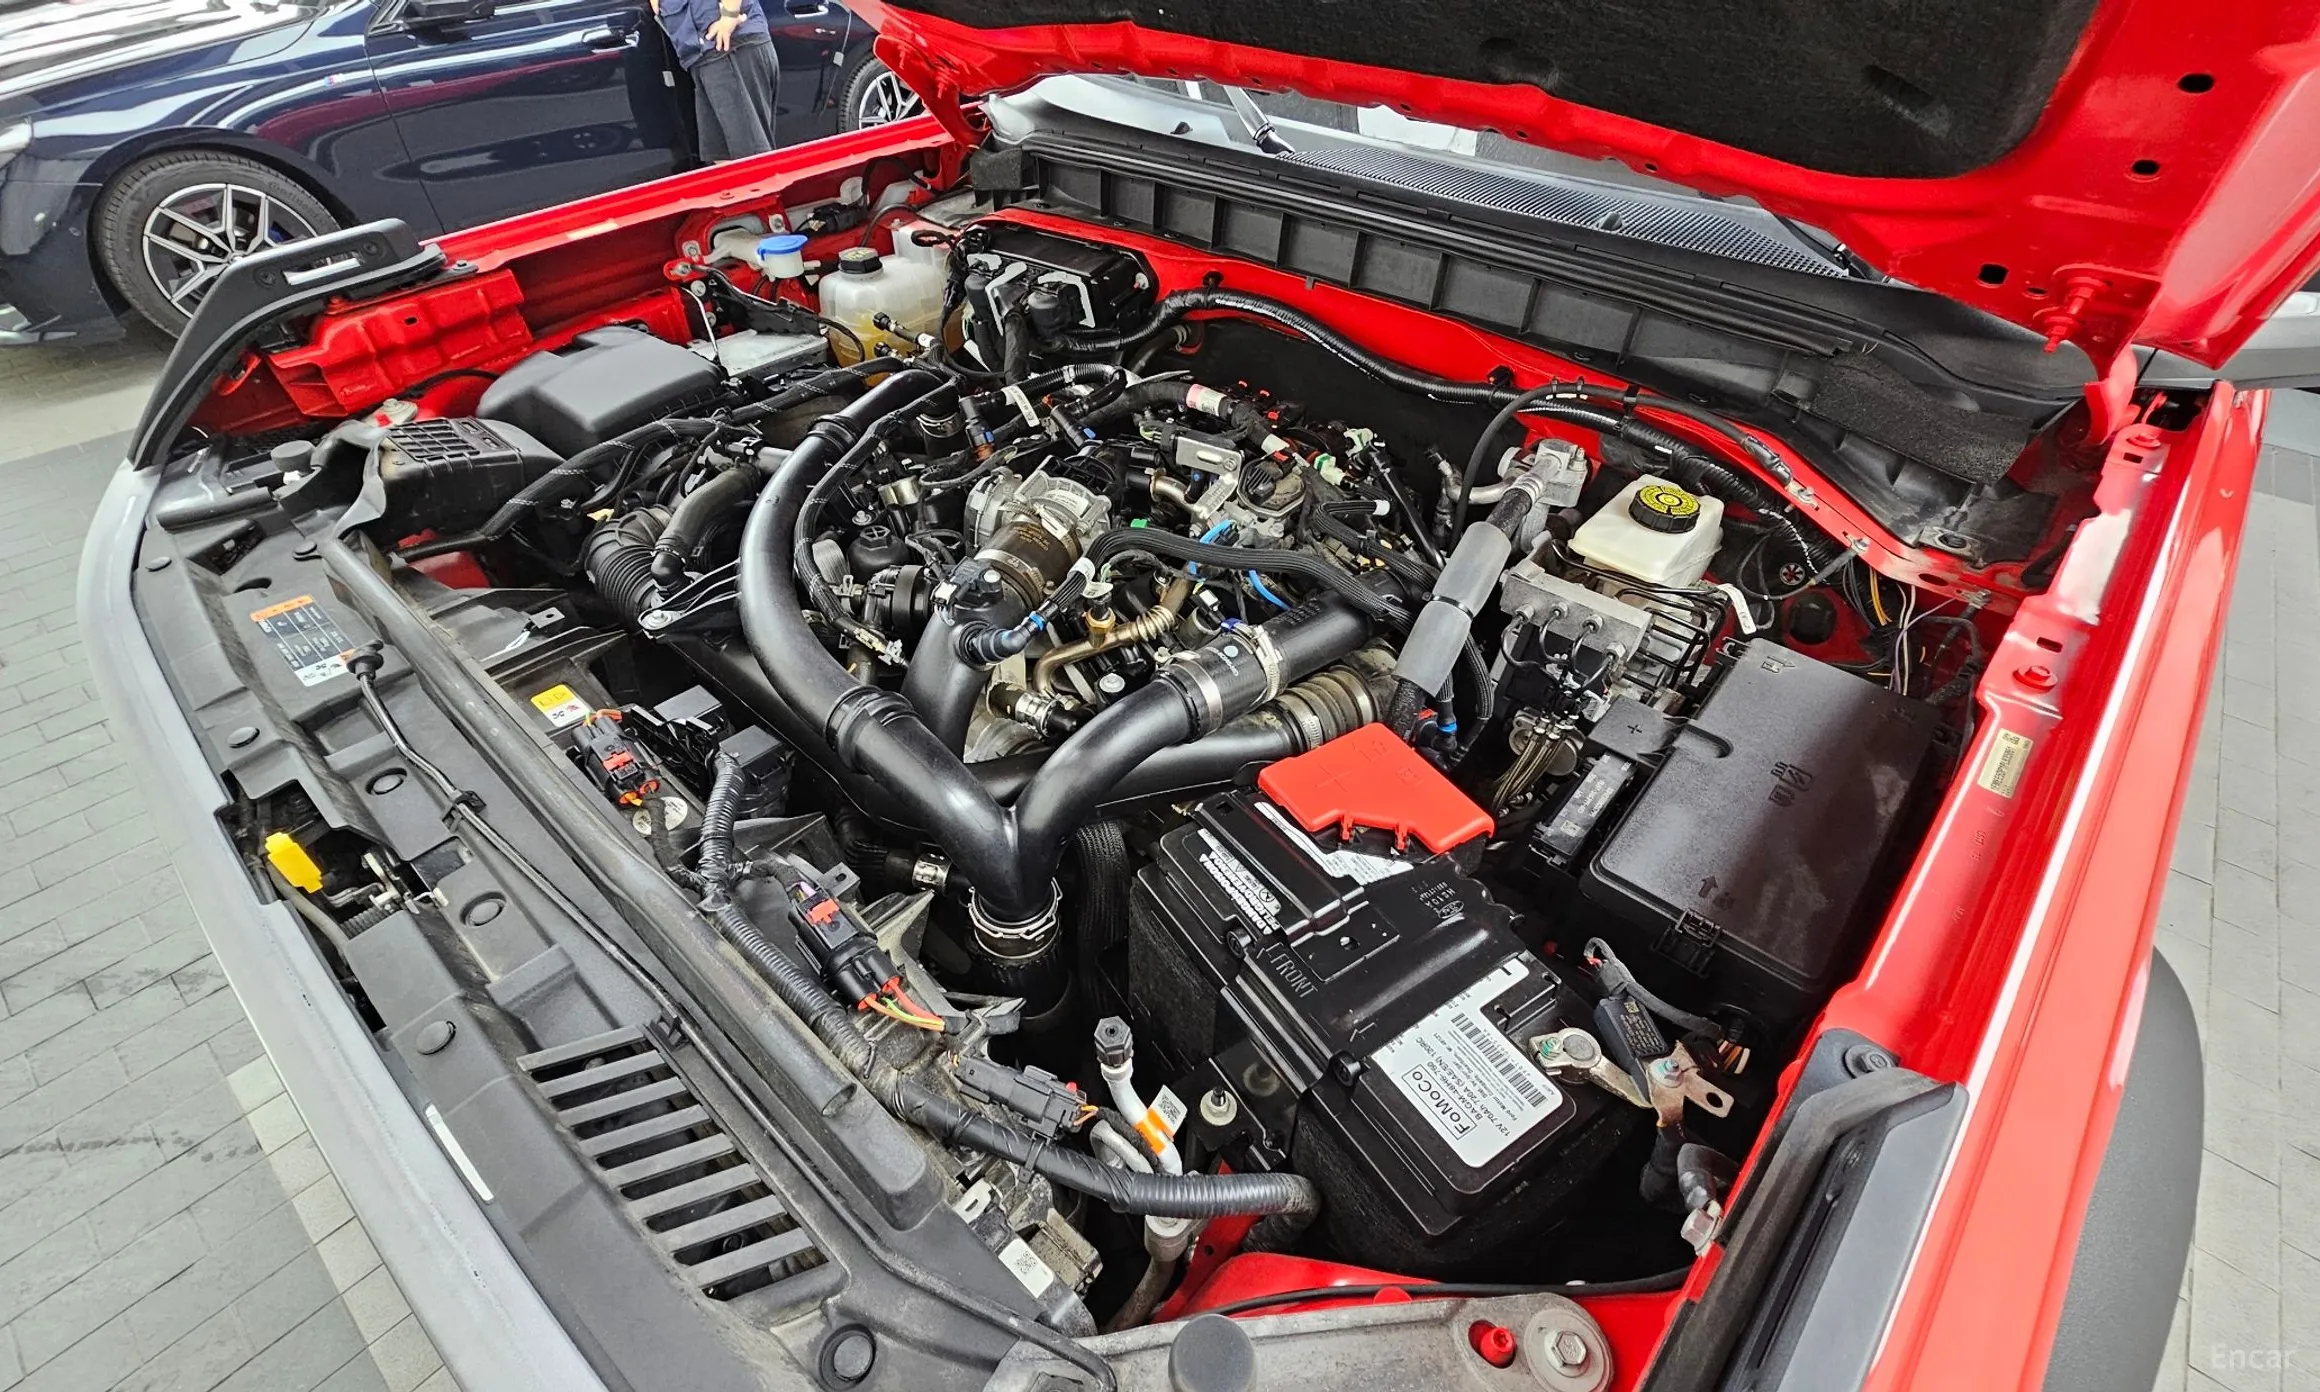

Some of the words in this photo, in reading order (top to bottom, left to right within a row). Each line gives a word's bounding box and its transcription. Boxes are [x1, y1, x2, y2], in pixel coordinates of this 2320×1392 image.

[1201, 857, 1267, 930] DANGER/POISON
[1212, 855, 1281, 930] PELIGRO/VENENO
[1270, 953, 1319, 998] FRONT
[1414, 1034, 1437, 1058] 120RC
[1408, 1068, 1471, 1135] FoMoCo
[1461, 1085, 1481, 1105] 720A
[1477, 1103, 1498, 1124] 70Ah
[1495, 1121, 1511, 1137] 12V
